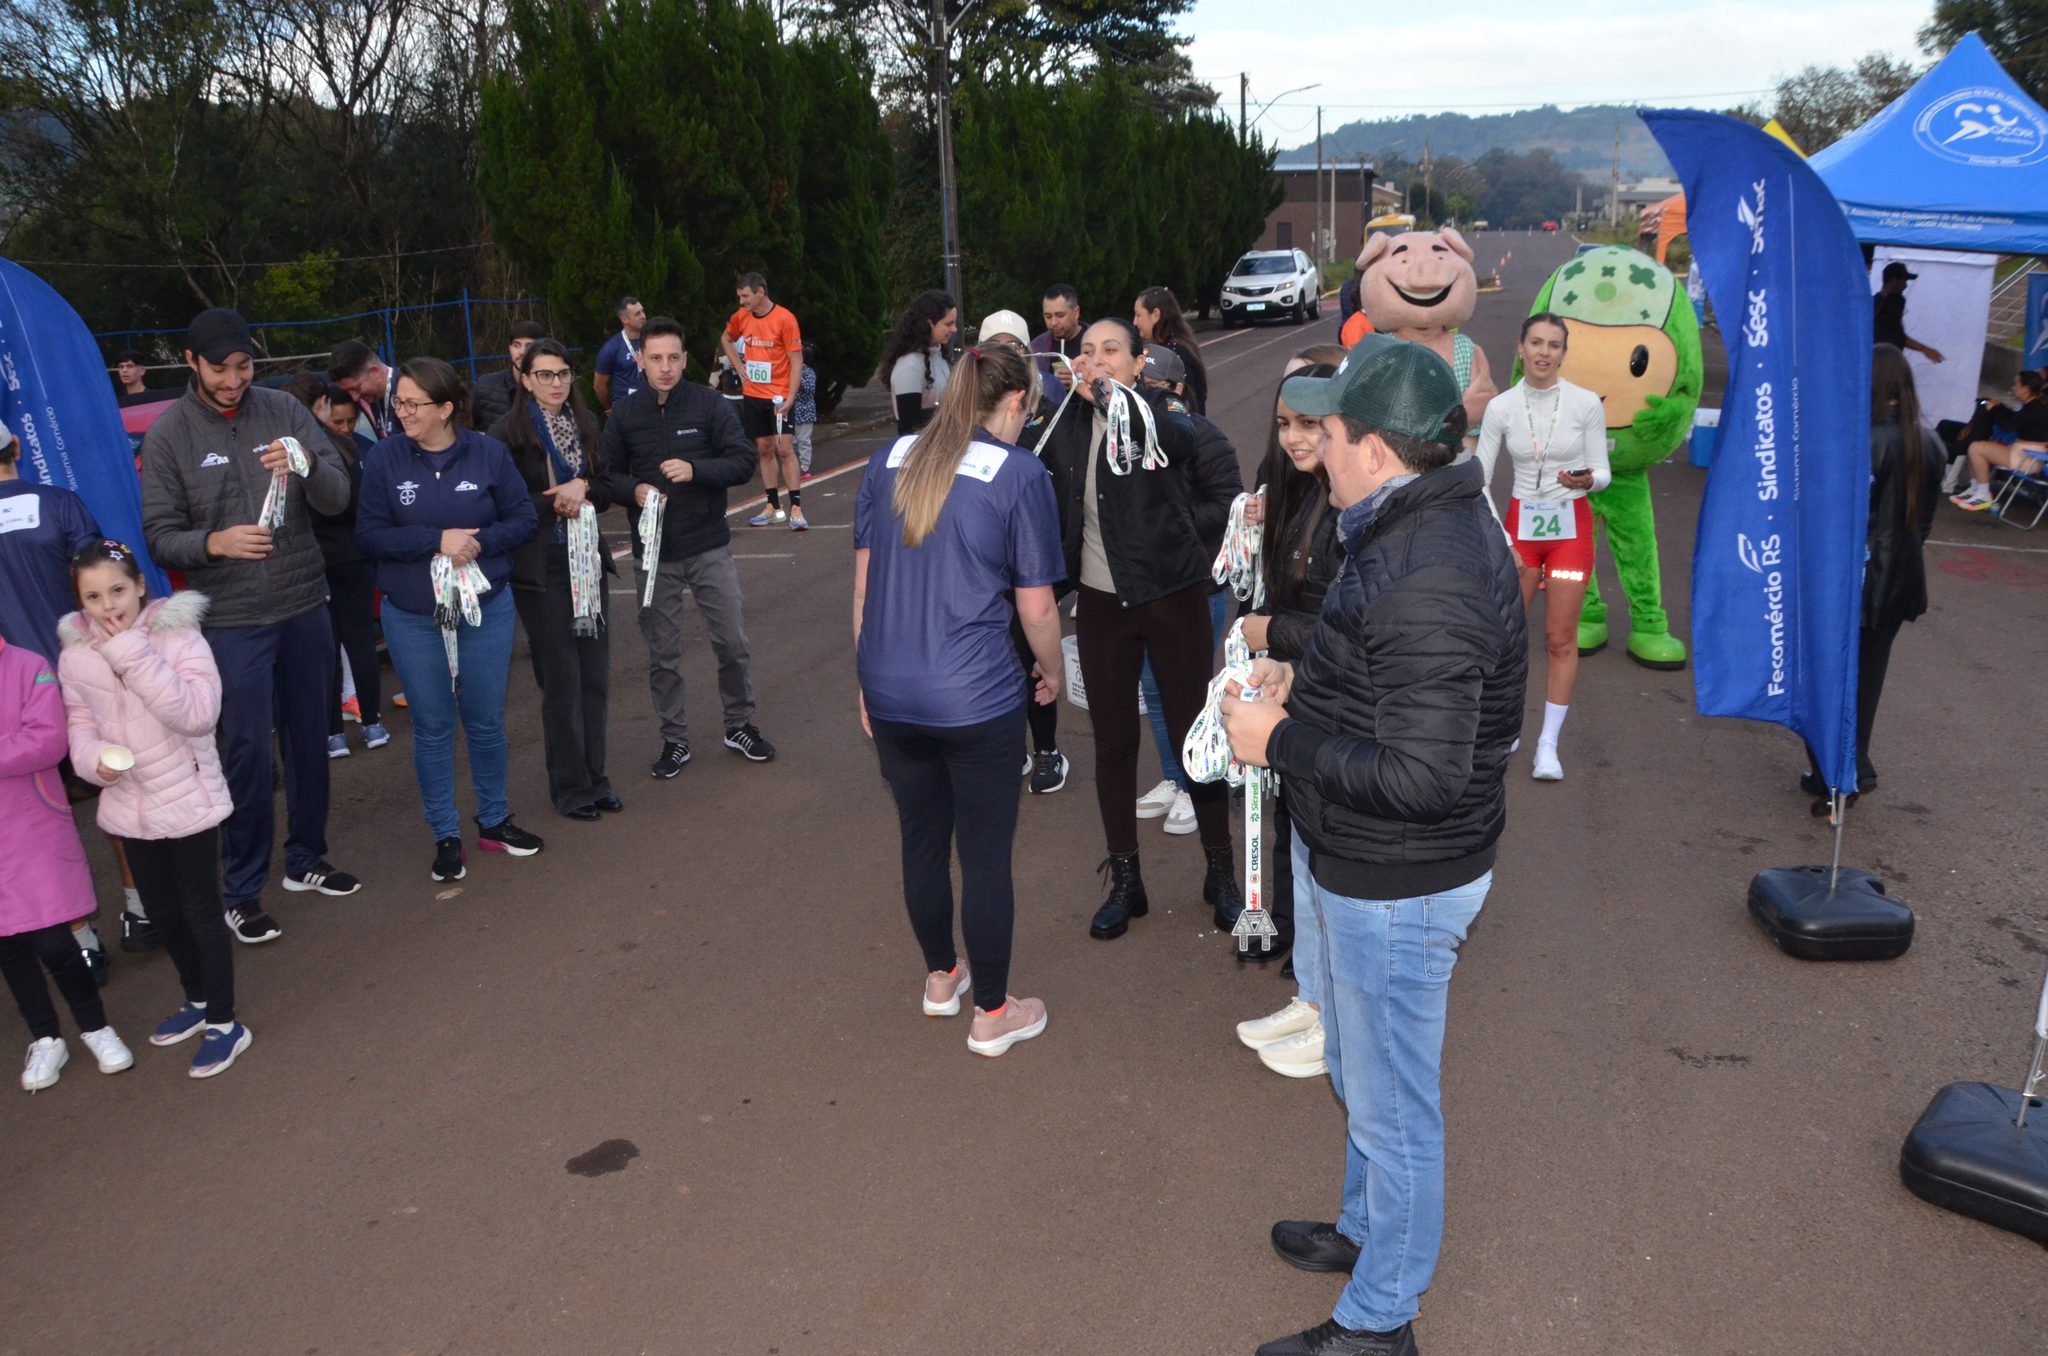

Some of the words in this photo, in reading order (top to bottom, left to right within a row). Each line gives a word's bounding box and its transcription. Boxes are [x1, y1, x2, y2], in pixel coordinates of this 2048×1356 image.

[1748, 288, 1769, 348] Sesc
[749, 369, 768, 382] 160
[46, 406, 65, 450] Comércio
[1755, 382, 1778, 501] Sindicatos
[21, 413, 53, 486] indicatos
[61, 451, 78, 491] Sistema
[1532, 514, 1562, 537] 24
[1761, 534, 1781, 566] RS
[1764, 571, 1784, 696] Fecomércio
[1251, 782, 1259, 811] Sicredi
[1251, 834, 1259, 871] CRESOL
